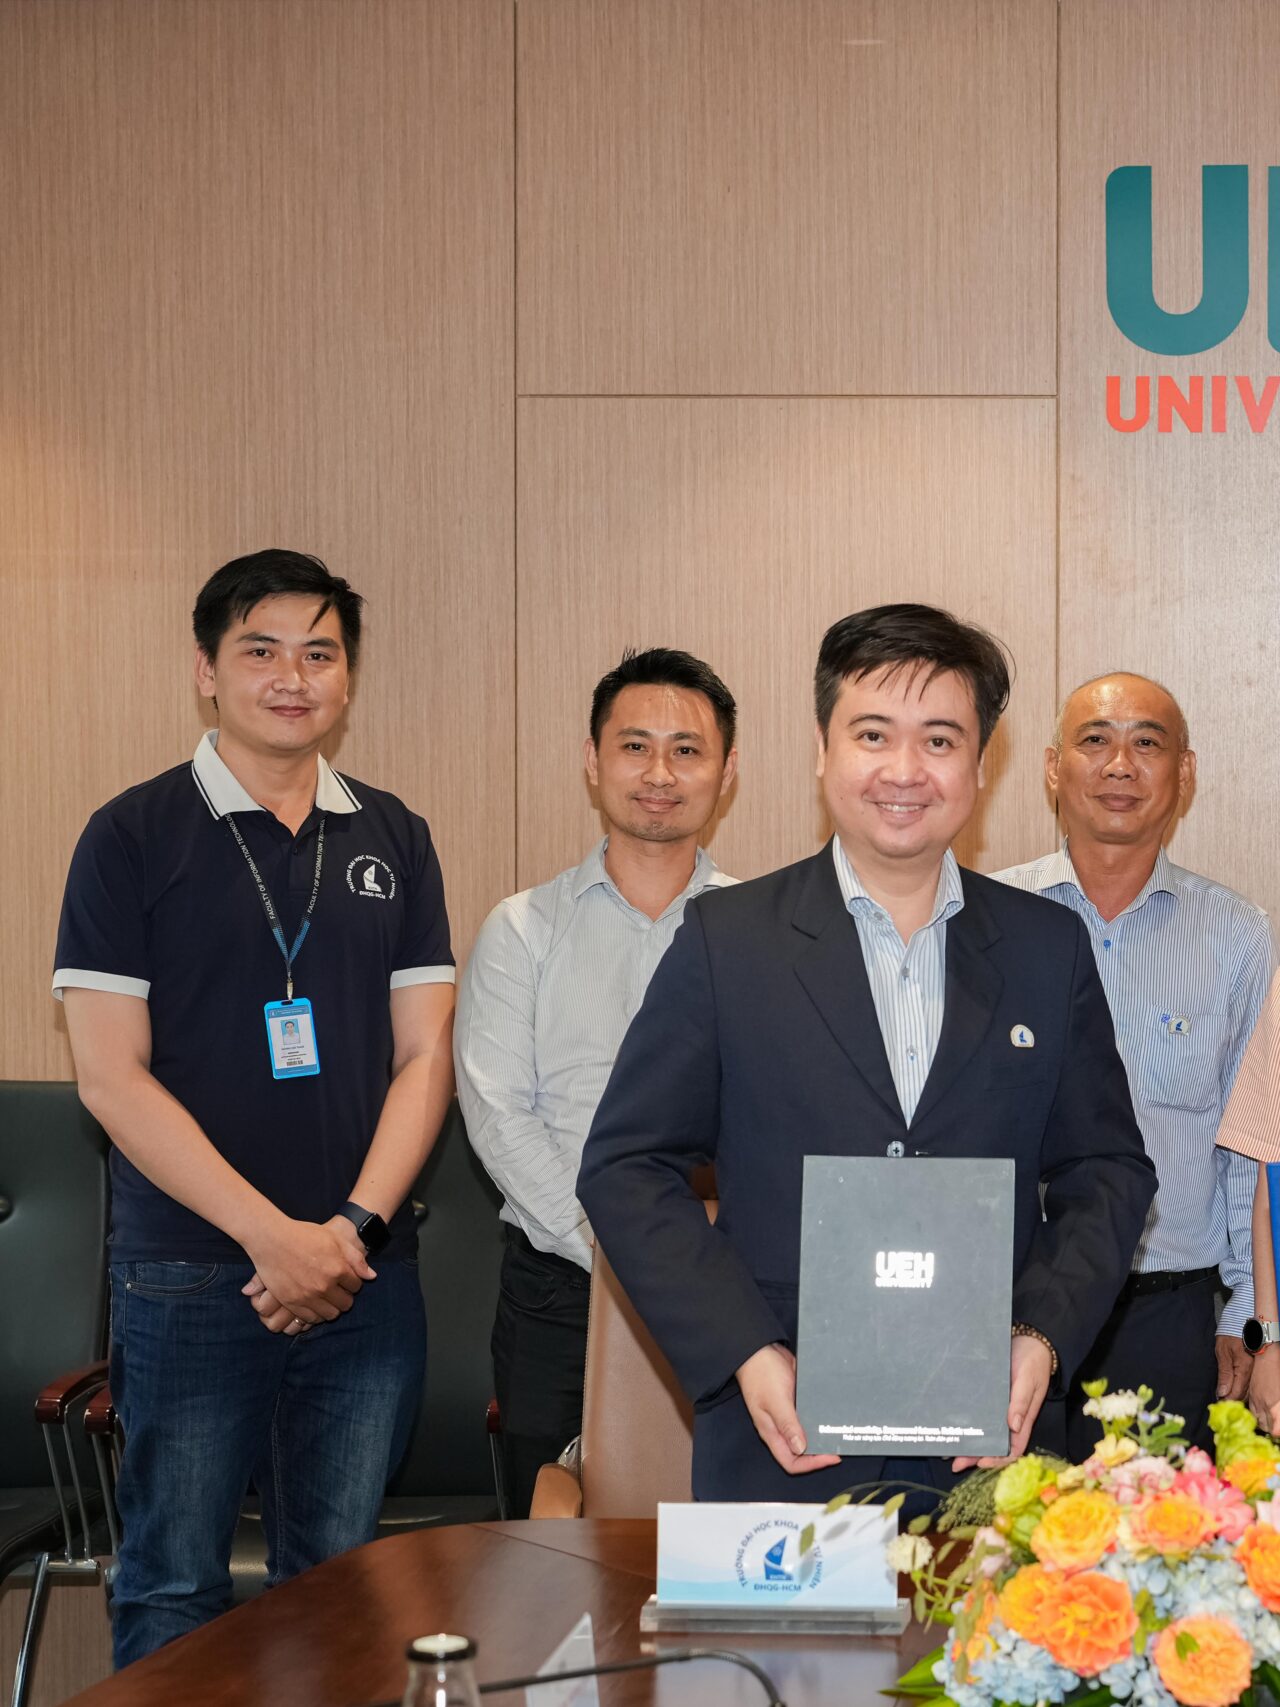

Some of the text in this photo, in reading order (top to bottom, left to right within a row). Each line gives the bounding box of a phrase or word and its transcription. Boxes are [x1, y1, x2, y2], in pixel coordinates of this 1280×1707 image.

[875, 1251, 935, 1279] UEH
[774, 1519, 799, 1531] KHOA
[753, 1583, 802, 1592] ĐHQG-HCM
